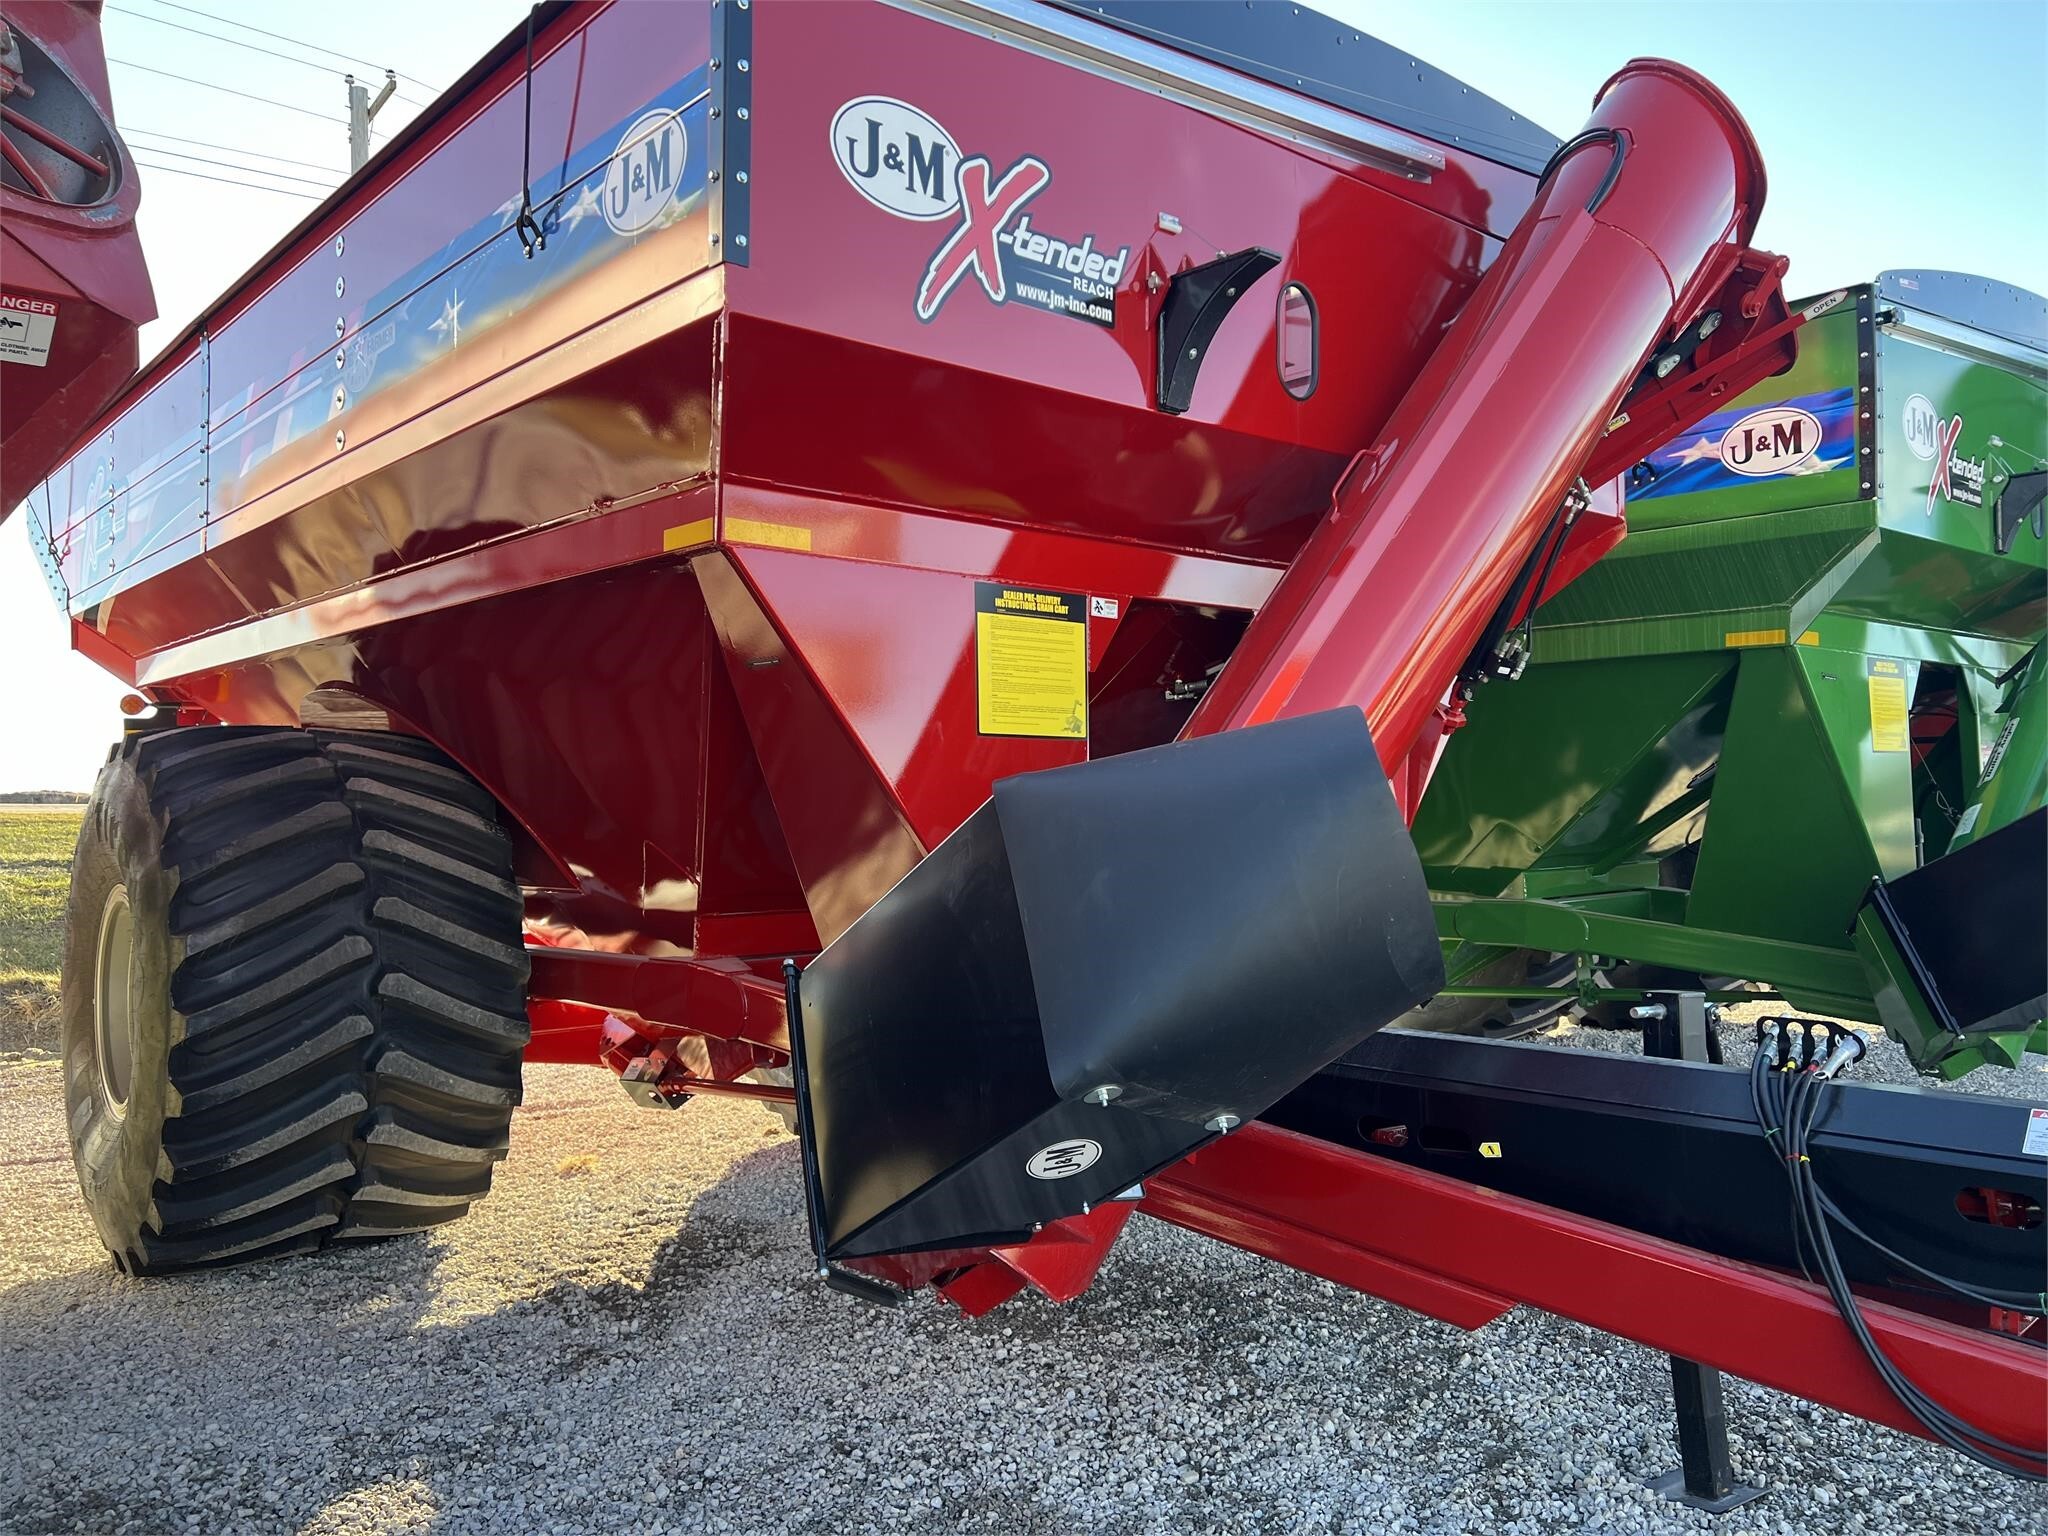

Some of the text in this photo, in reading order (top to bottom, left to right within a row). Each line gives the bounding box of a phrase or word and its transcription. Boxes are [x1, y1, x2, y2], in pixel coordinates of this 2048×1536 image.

[611, 126, 672, 219] J&M
[845, 117, 947, 203] J&M
[1015, 281, 1113, 323] www.jm-inc.com
[1072, 275, 1114, 301] REACH
[0, 295, 56, 315] NGER
[1812, 296, 1838, 314] OPEN
[1729, 418, 1804, 465] J&M
[1906, 407, 1935, 449] J&M
[995, 597, 1036, 611] INSTRUCTIONS
[1037, 602, 1054, 613] GRAIN
[1054, 604, 1069, 615] CART
[1003, 590, 1061, 606] DEALER PRE-DELIVERY
[1043, 1144, 1086, 1175] J&M
